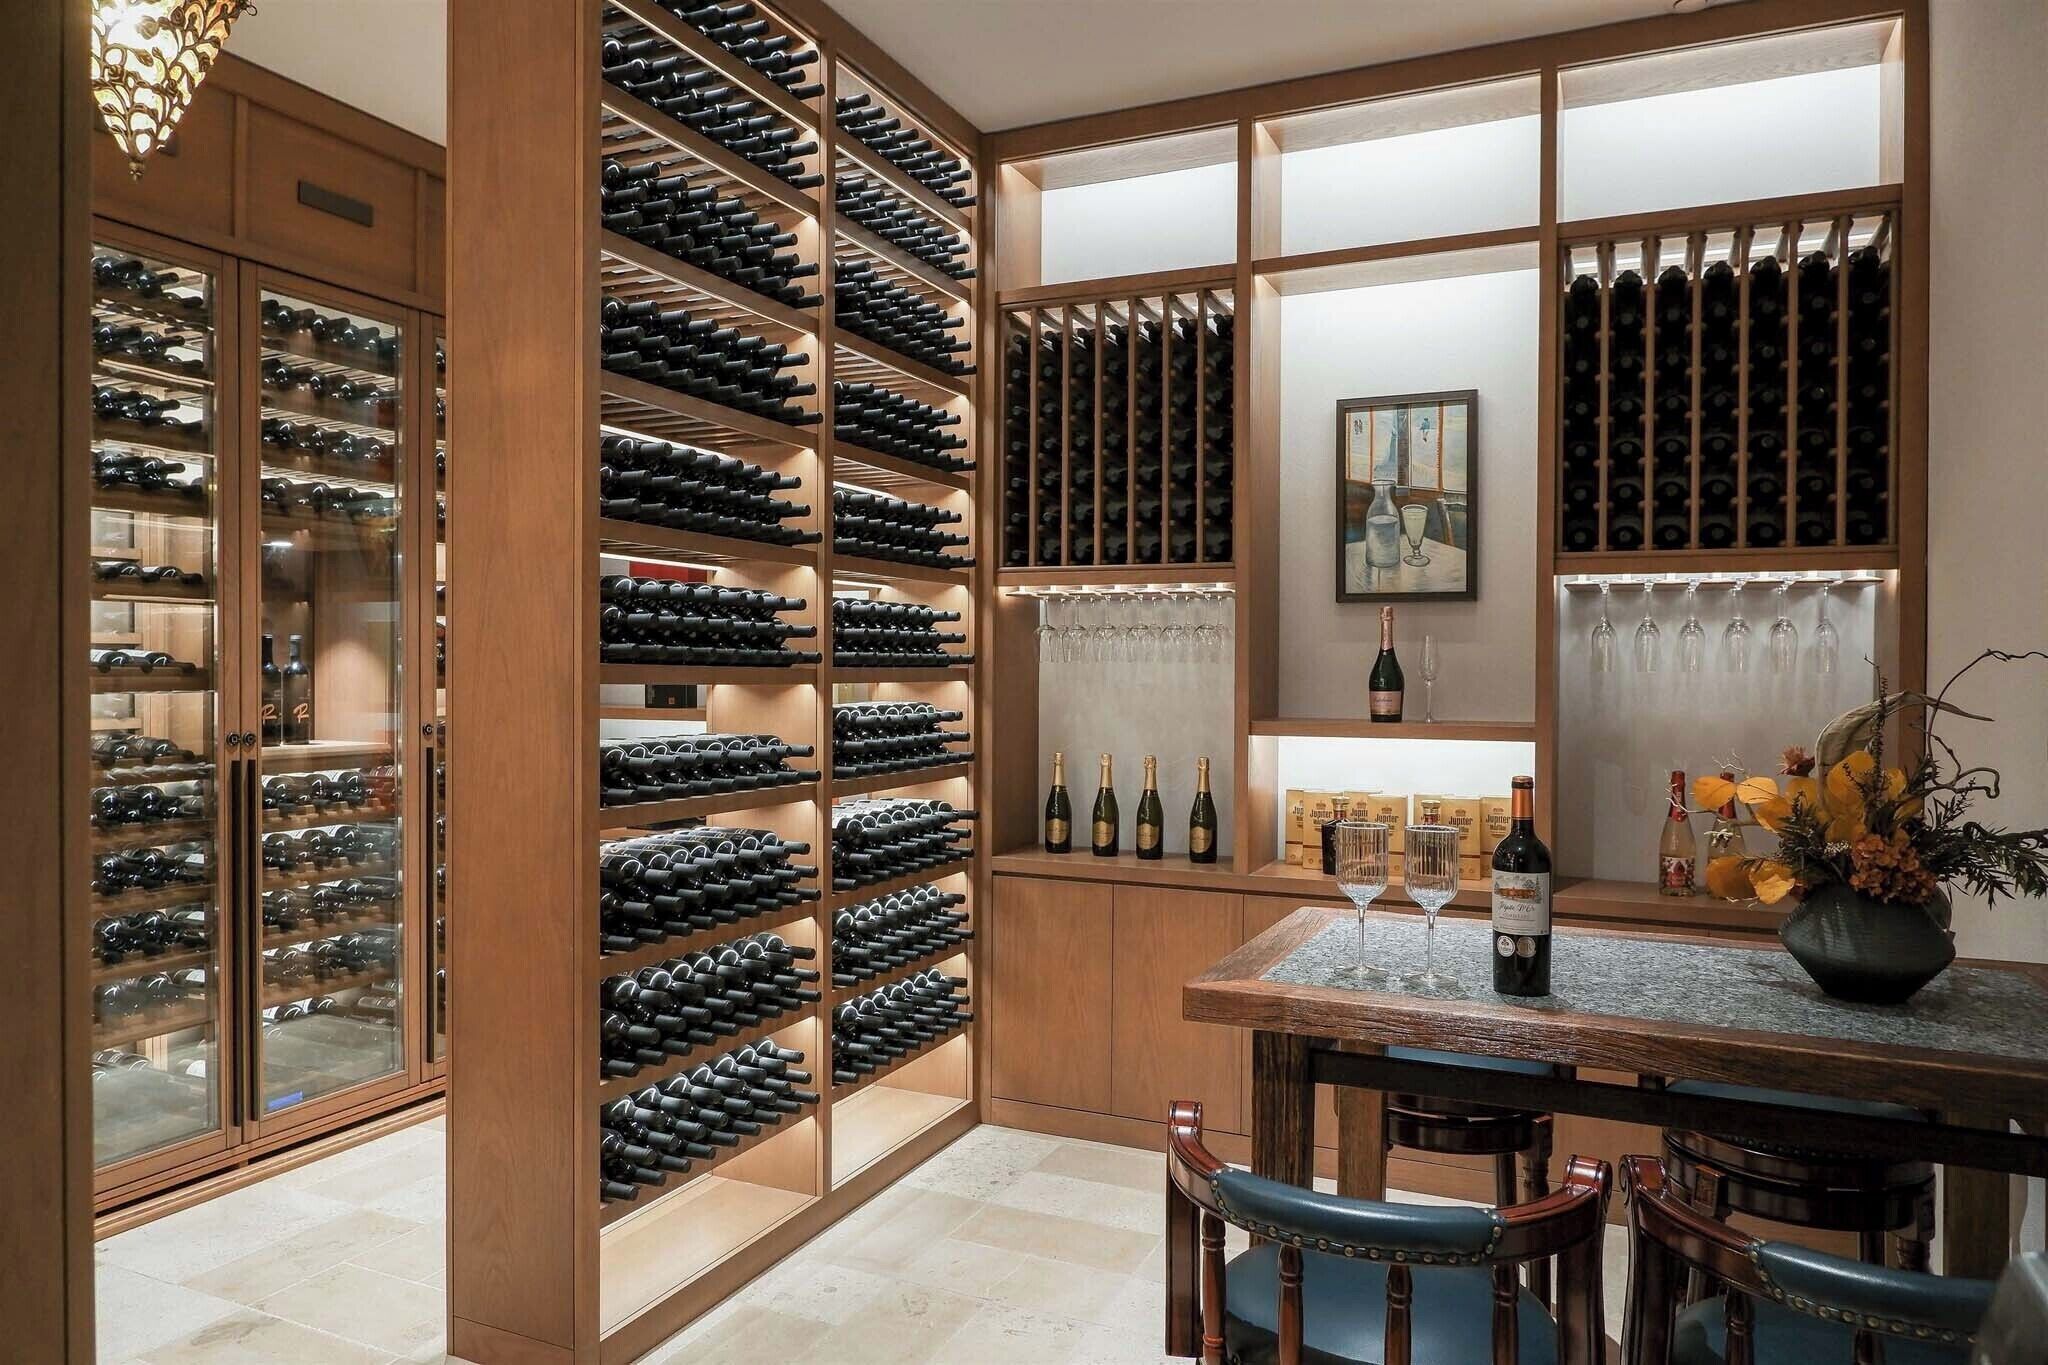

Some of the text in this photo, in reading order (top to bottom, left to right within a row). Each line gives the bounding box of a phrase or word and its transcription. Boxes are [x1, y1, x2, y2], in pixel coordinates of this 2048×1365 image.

[293, 703, 310, 724] R
[1310, 809, 1333, 819] Jupiter
[1374, 813, 1399, 824] Jupiter
[1486, 814, 1511, 825] Jupiter
[1448, 815, 1473, 826] Jupiter
